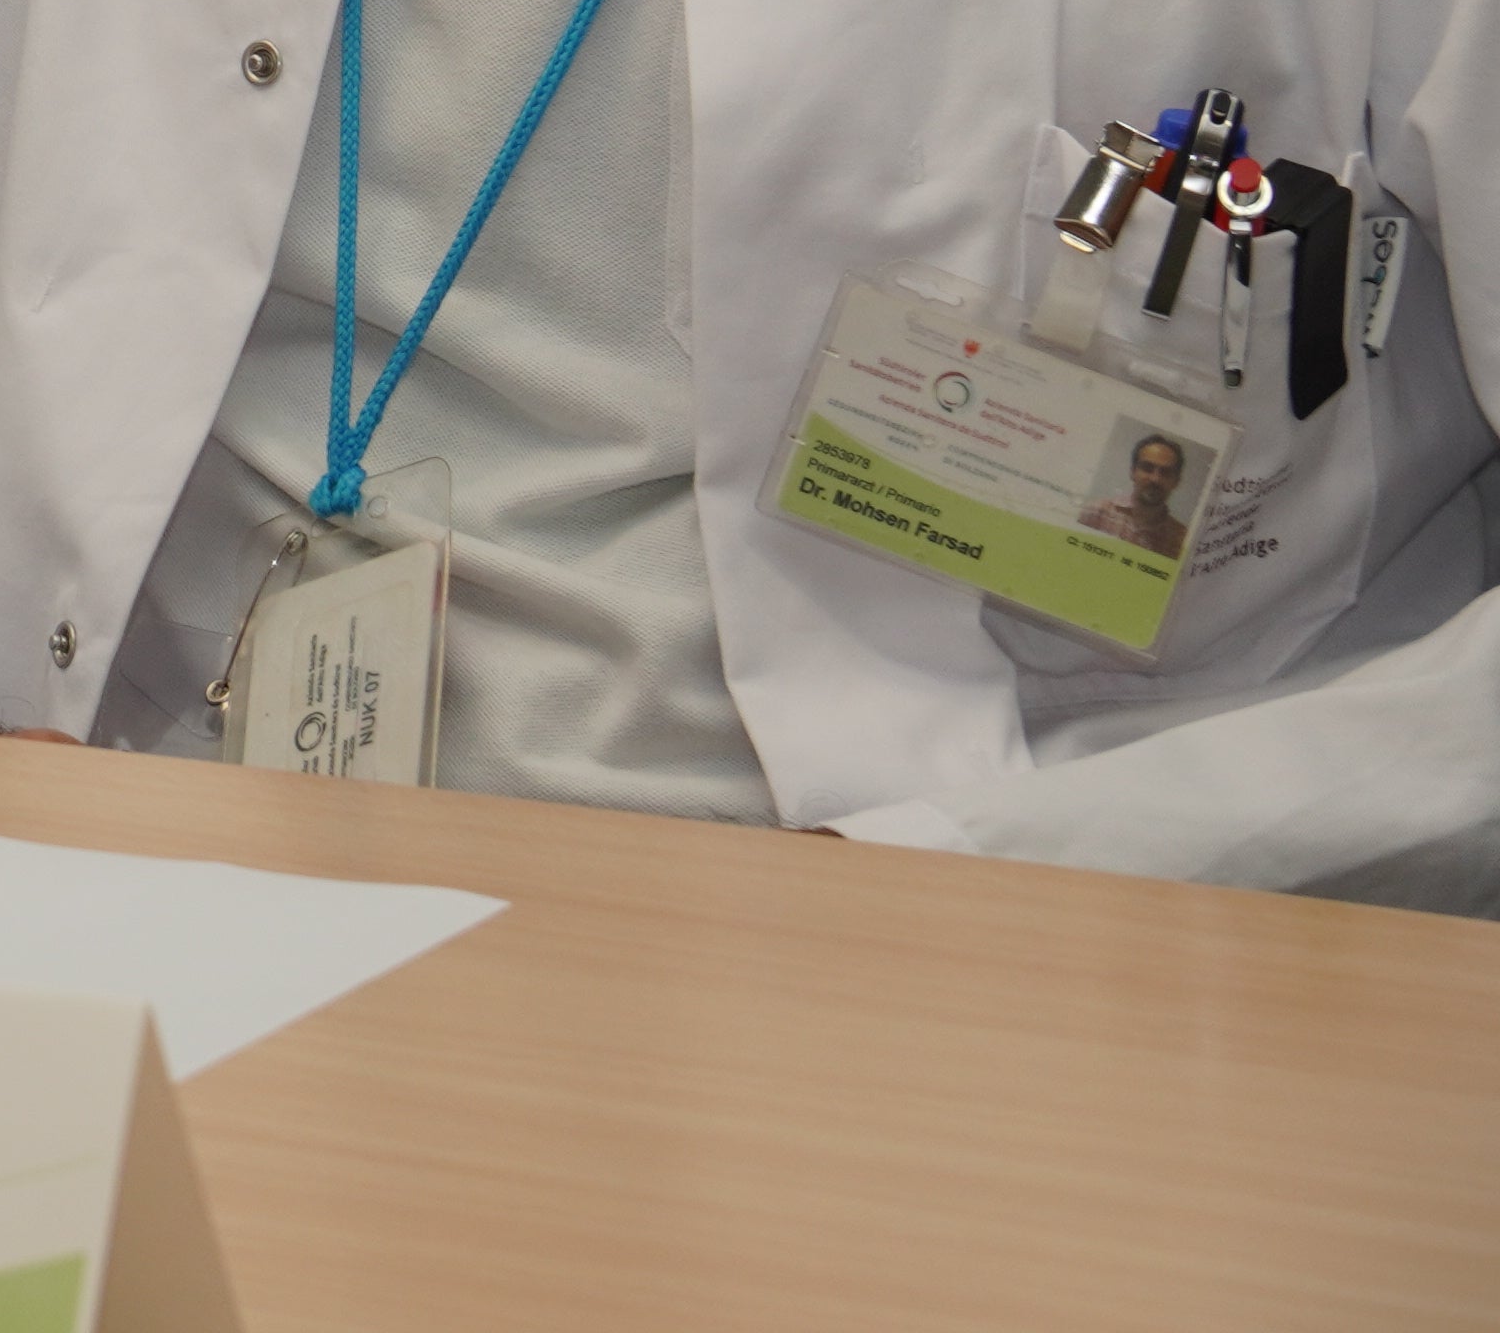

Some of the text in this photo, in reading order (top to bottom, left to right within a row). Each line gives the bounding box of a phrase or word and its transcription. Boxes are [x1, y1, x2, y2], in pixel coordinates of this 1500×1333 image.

[800, 477, 984, 561] Dr. Mohsen Farsad
[808, 457, 875, 493] Primararzt
[886, 486, 941, 518] Primario
